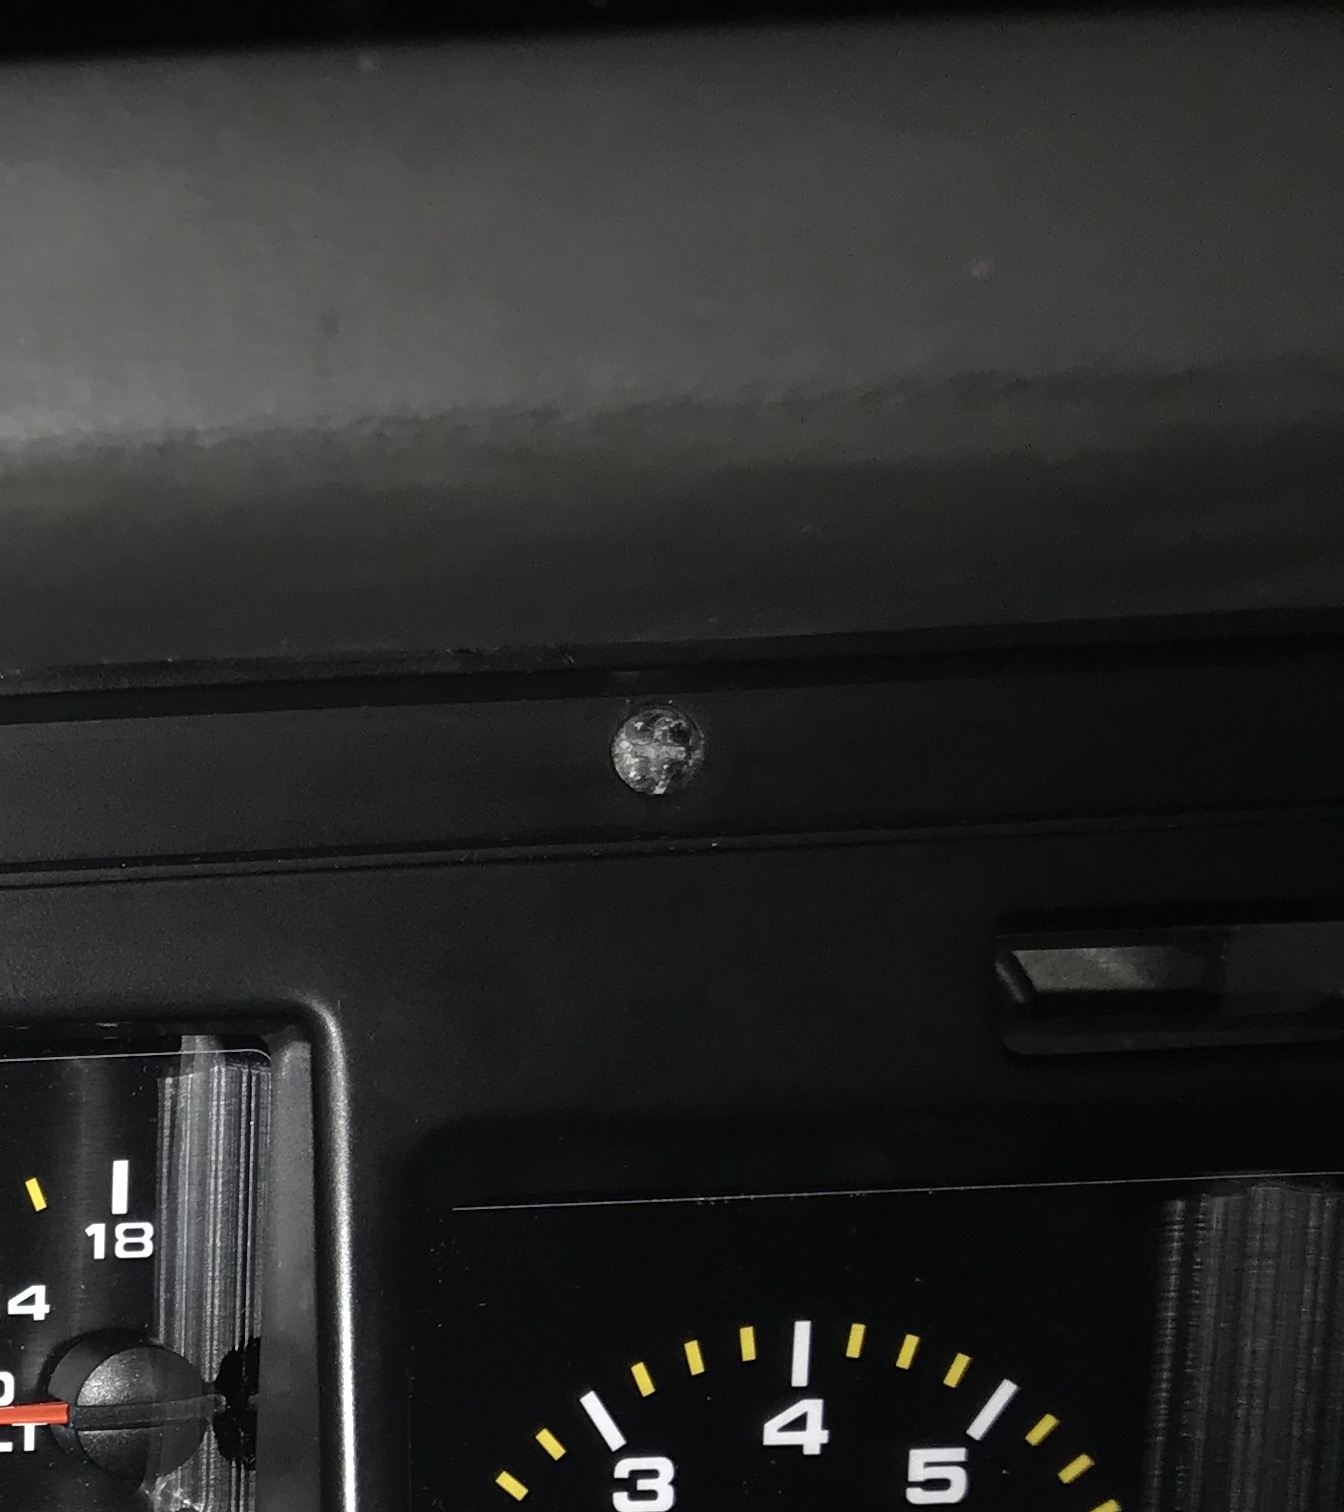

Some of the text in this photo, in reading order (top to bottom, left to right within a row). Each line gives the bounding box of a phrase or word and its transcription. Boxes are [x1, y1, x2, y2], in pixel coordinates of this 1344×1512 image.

[84, 1221, 155, 1260] 18
[762, 1398, 830, 1455] 4
[905, 1447, 967, 1505] 5
